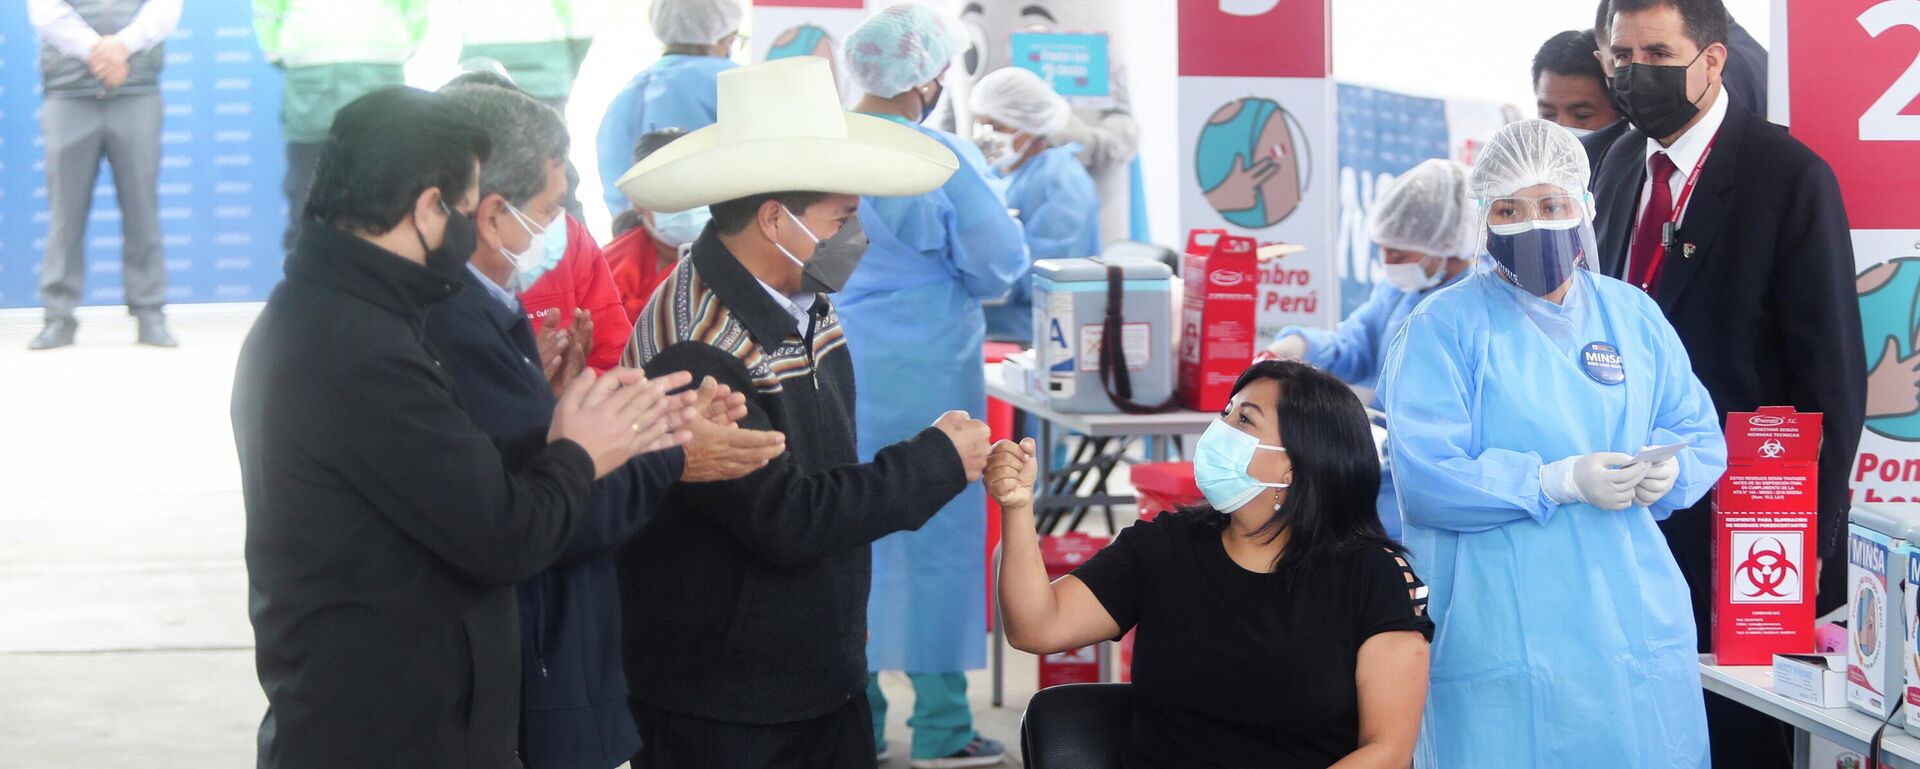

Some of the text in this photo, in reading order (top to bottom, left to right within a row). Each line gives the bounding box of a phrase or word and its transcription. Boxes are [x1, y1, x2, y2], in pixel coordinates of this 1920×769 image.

[1856, 0, 1920, 141] 2
[1264, 289, 1317, 314] Perú
[1585, 351, 1622, 365] MINSA
[1852, 538, 1885, 575] MINSA
